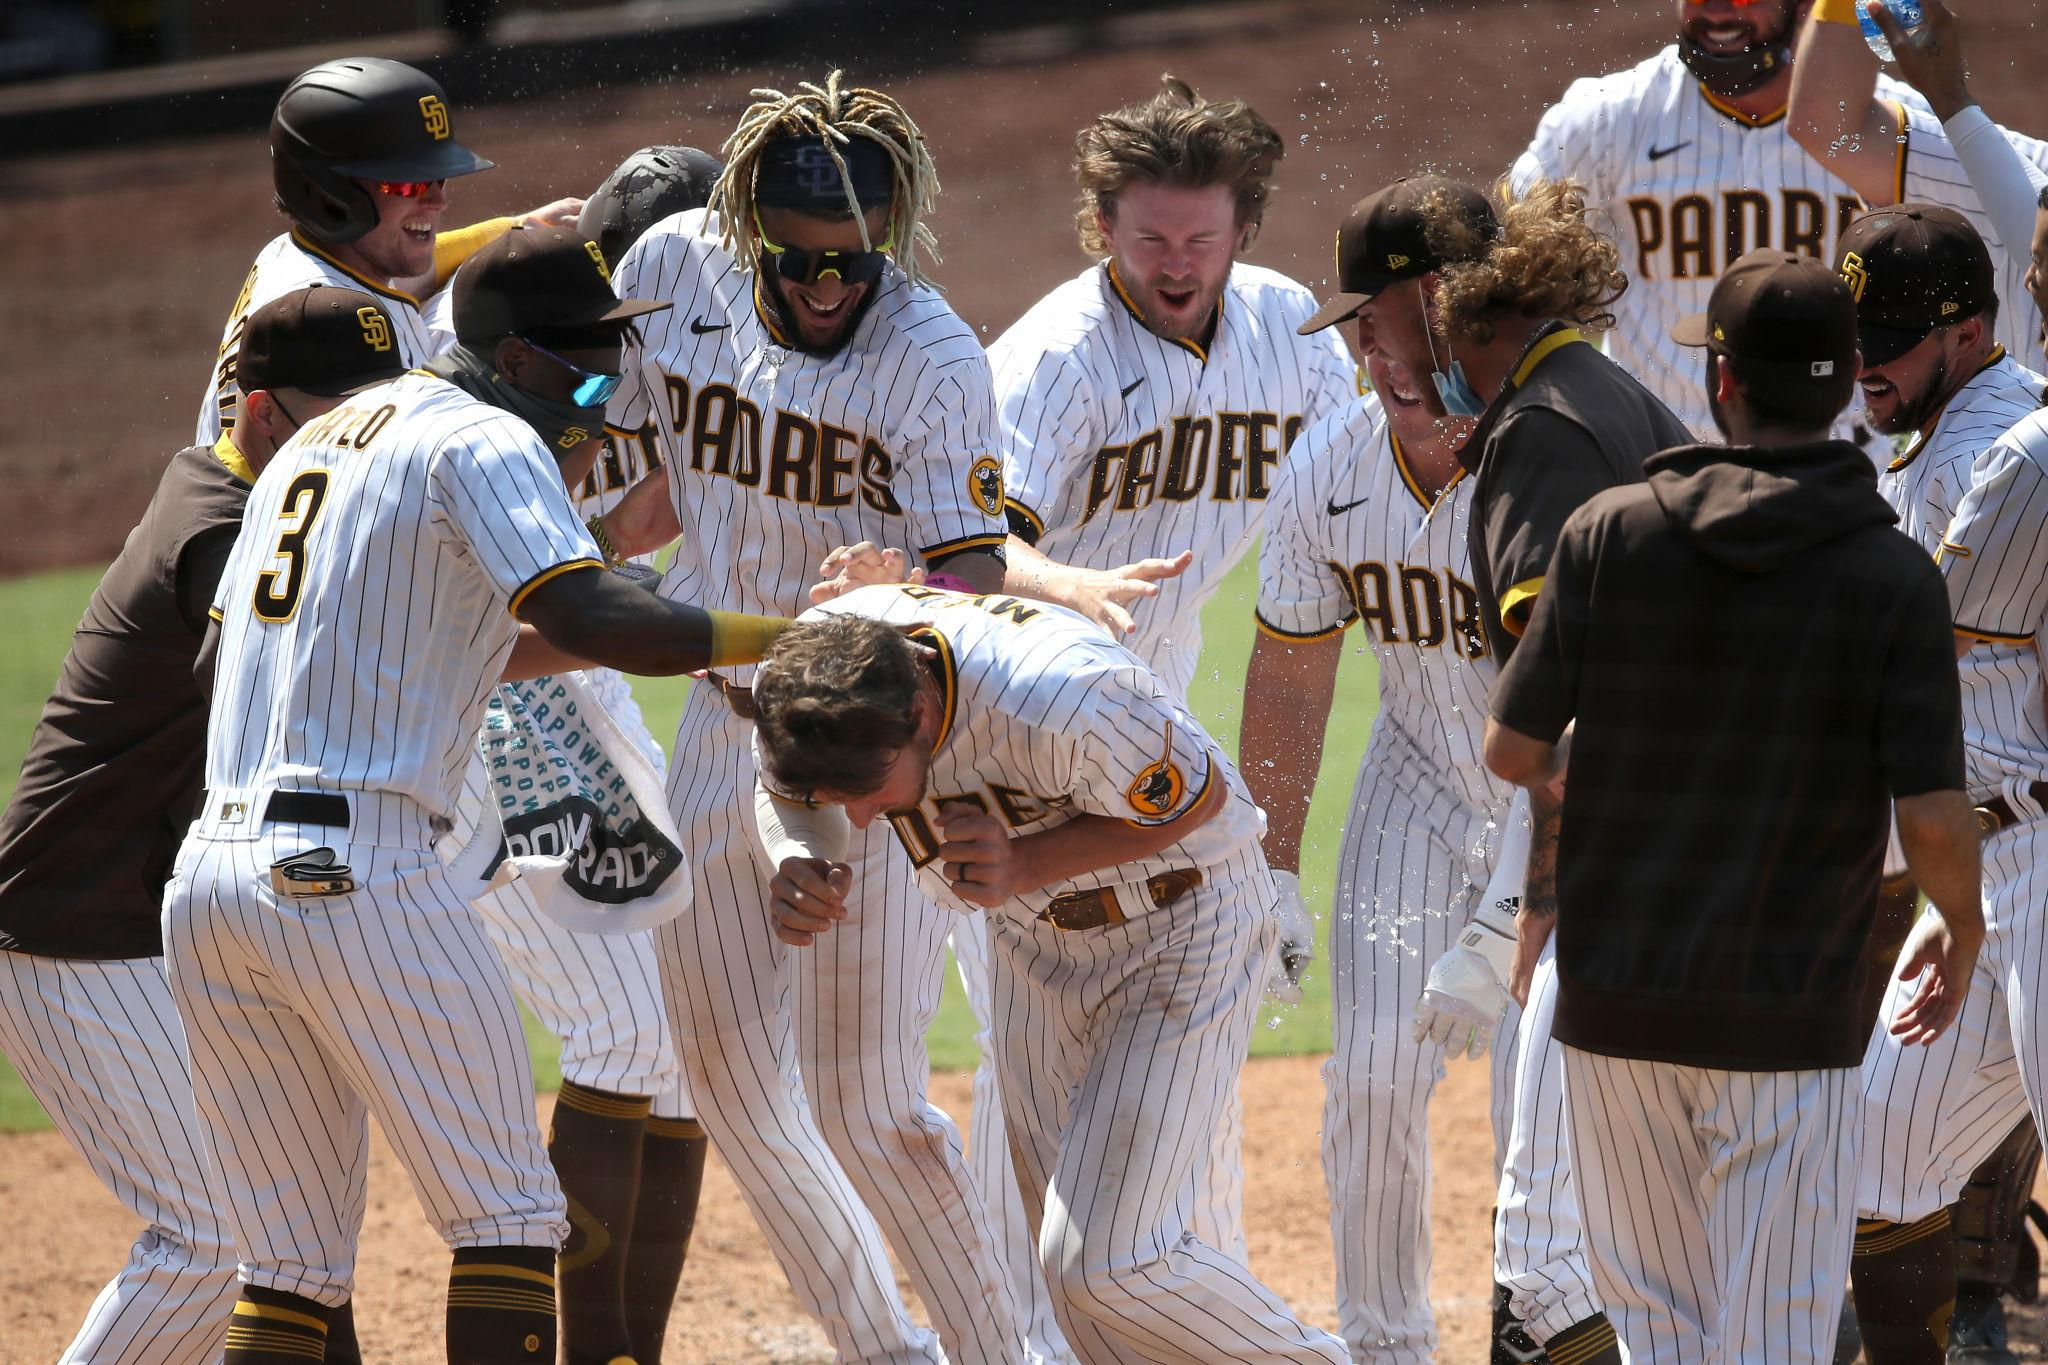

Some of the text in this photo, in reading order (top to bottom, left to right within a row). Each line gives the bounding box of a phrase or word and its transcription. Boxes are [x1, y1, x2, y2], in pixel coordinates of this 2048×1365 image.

[1627, 188, 1867, 280] PADR
[663, 373, 903, 516] PADRES
[252, 468, 332, 623] 3
[1328, 560, 1487, 660] ADR
